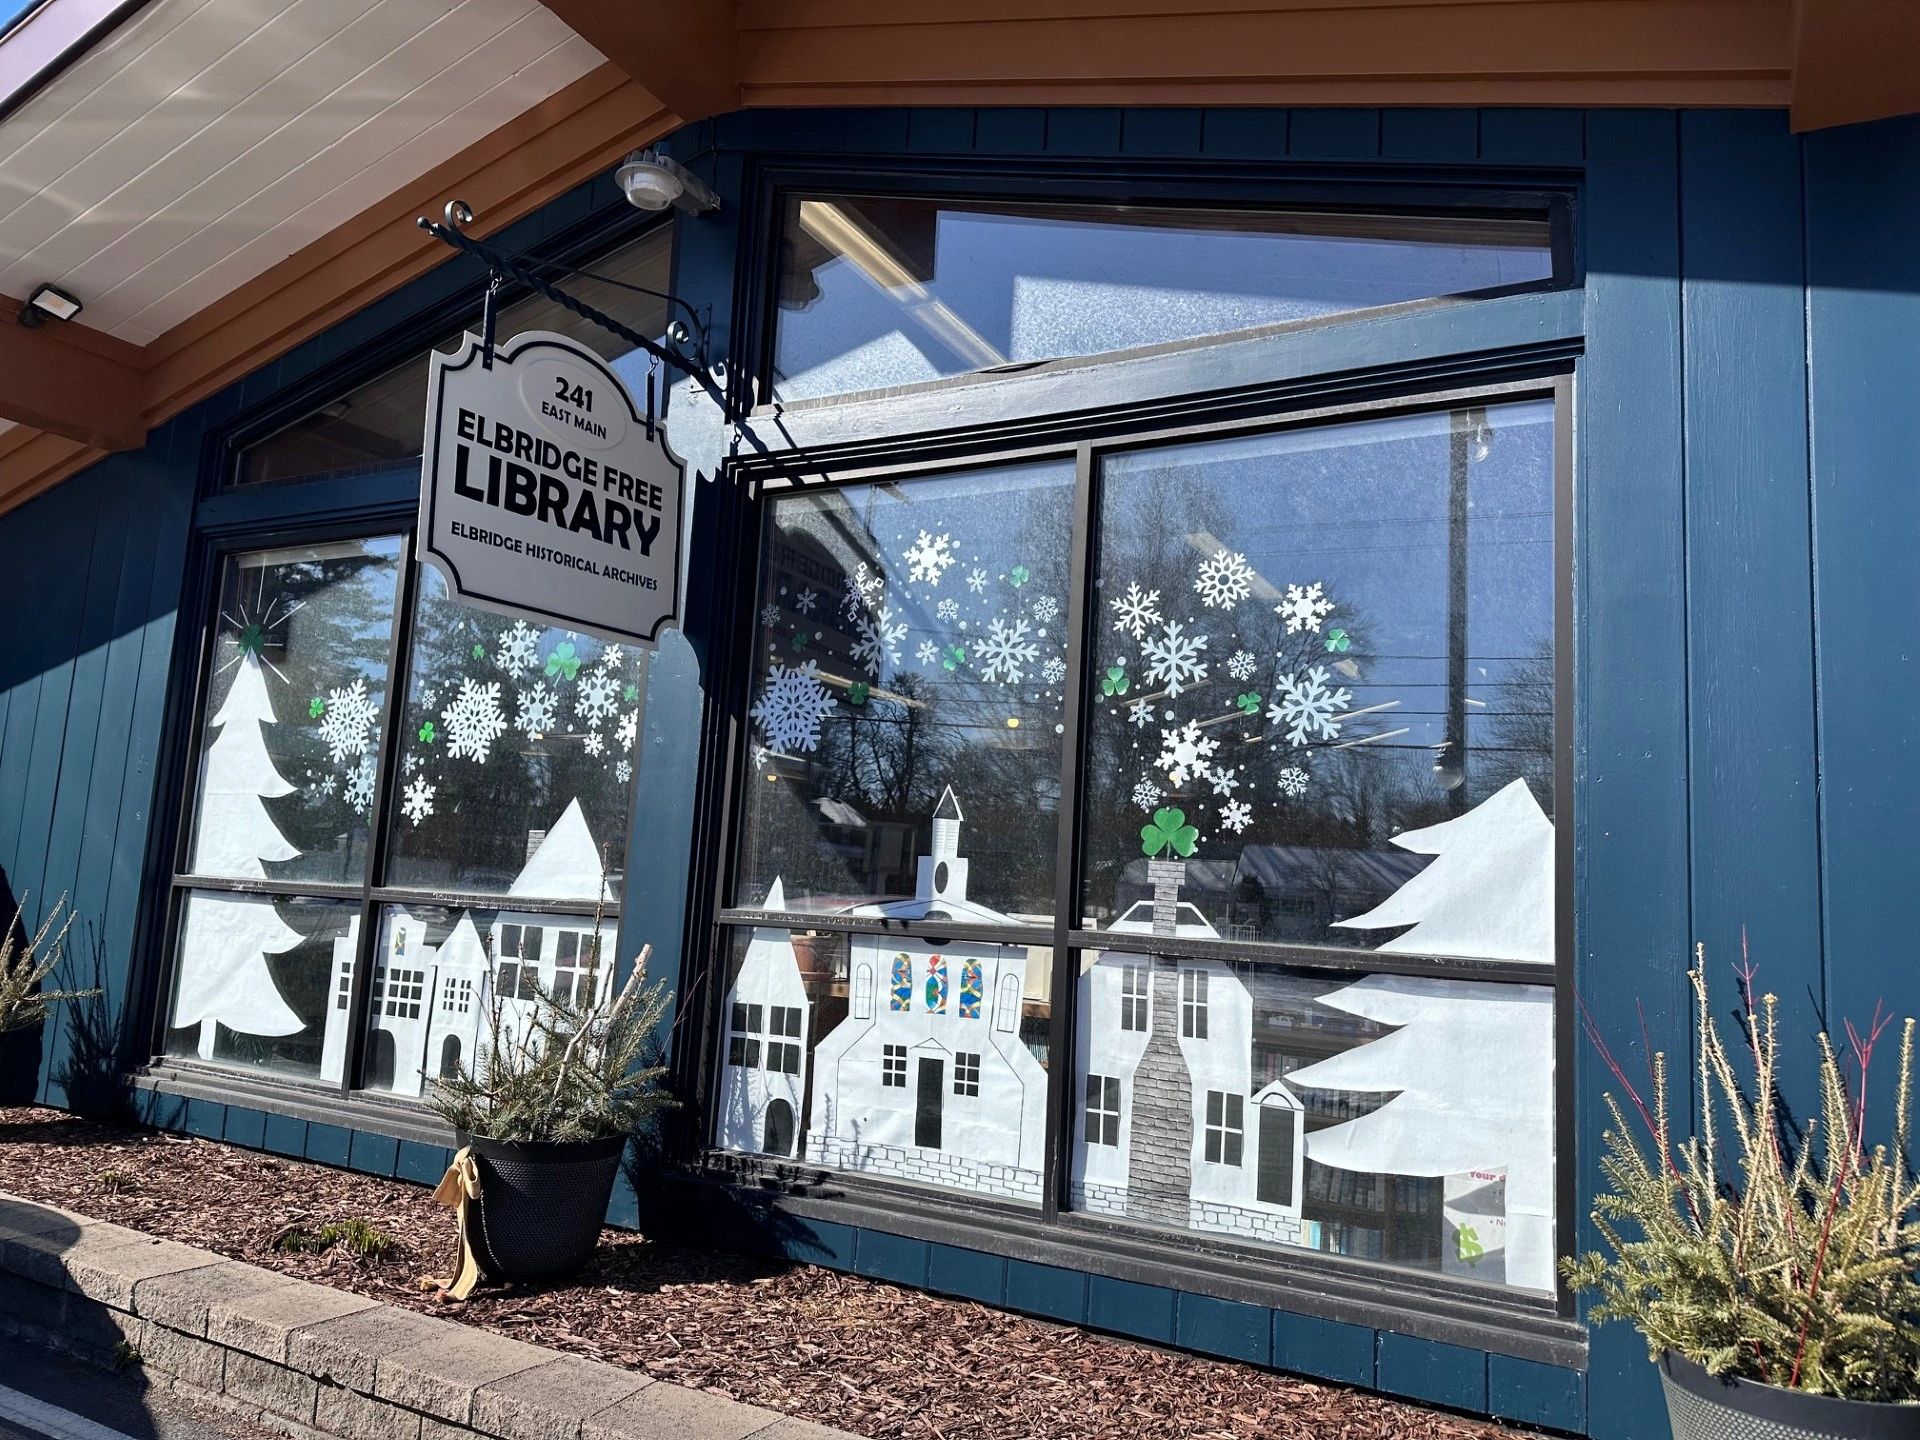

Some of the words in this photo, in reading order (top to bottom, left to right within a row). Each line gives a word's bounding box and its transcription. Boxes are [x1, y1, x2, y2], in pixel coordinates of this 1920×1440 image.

[541, 401, 571, 425] EAST
[574, 416, 607, 440] MAIN
[555, 376, 592, 413] 241
[457, 407, 598, 487] ELBRIDGE
[603, 465, 663, 512] FREE
[454, 443, 661, 557] LIBRARY
[451, 520, 522, 554] ELBRIDGE
[525, 542, 600, 576] HISTORICAL
[602, 564, 658, 591] ARCHIVES
[1470, 1171, 1496, 1181] Your
